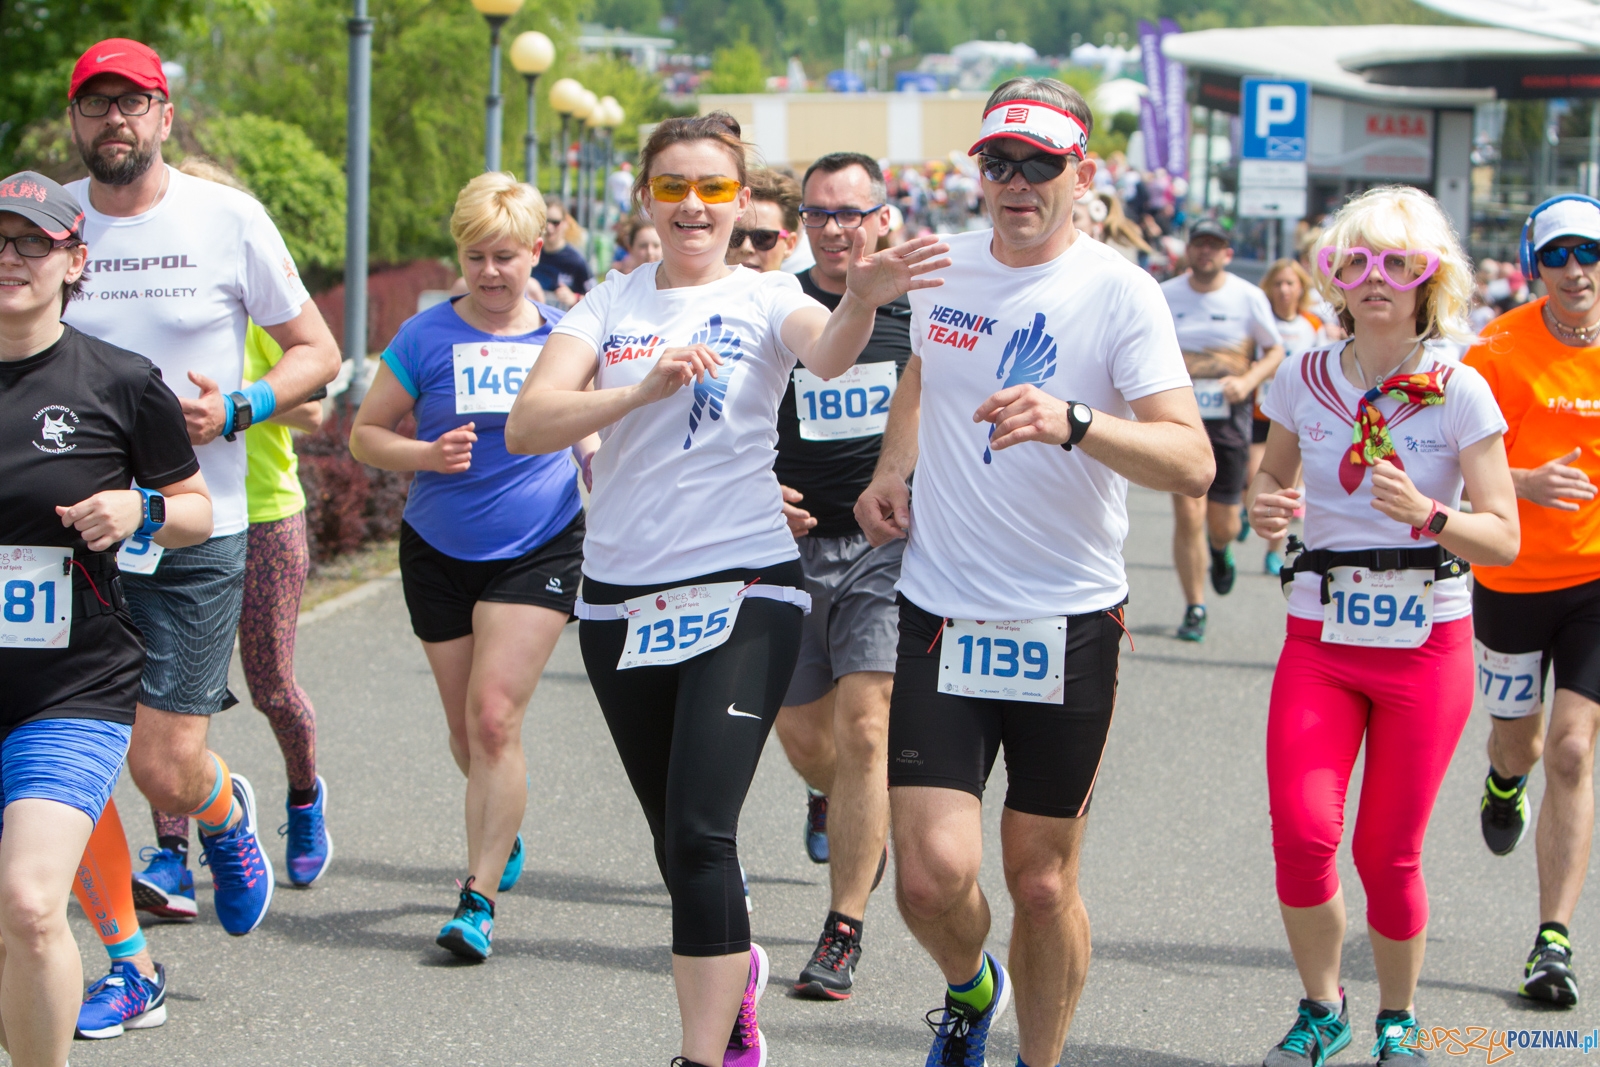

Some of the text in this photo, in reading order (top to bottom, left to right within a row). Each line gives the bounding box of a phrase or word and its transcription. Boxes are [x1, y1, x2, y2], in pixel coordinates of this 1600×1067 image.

[1255, 84, 1297, 138] P
[1365, 113, 1427, 136] KASA
[145, 288, 197, 298] ROLETY
[929, 304, 999, 336] HERNIK
[928, 324, 979, 352] TEAM
[605, 347, 654, 367] TEAM
[33, 405, 70, 421] TAEKWONDO
[803, 385, 891, 420] 1802
[1332, 591, 1426, 628] 1694
[637, 608, 730, 654] 1355
[958, 635, 1048, 680] 1139
